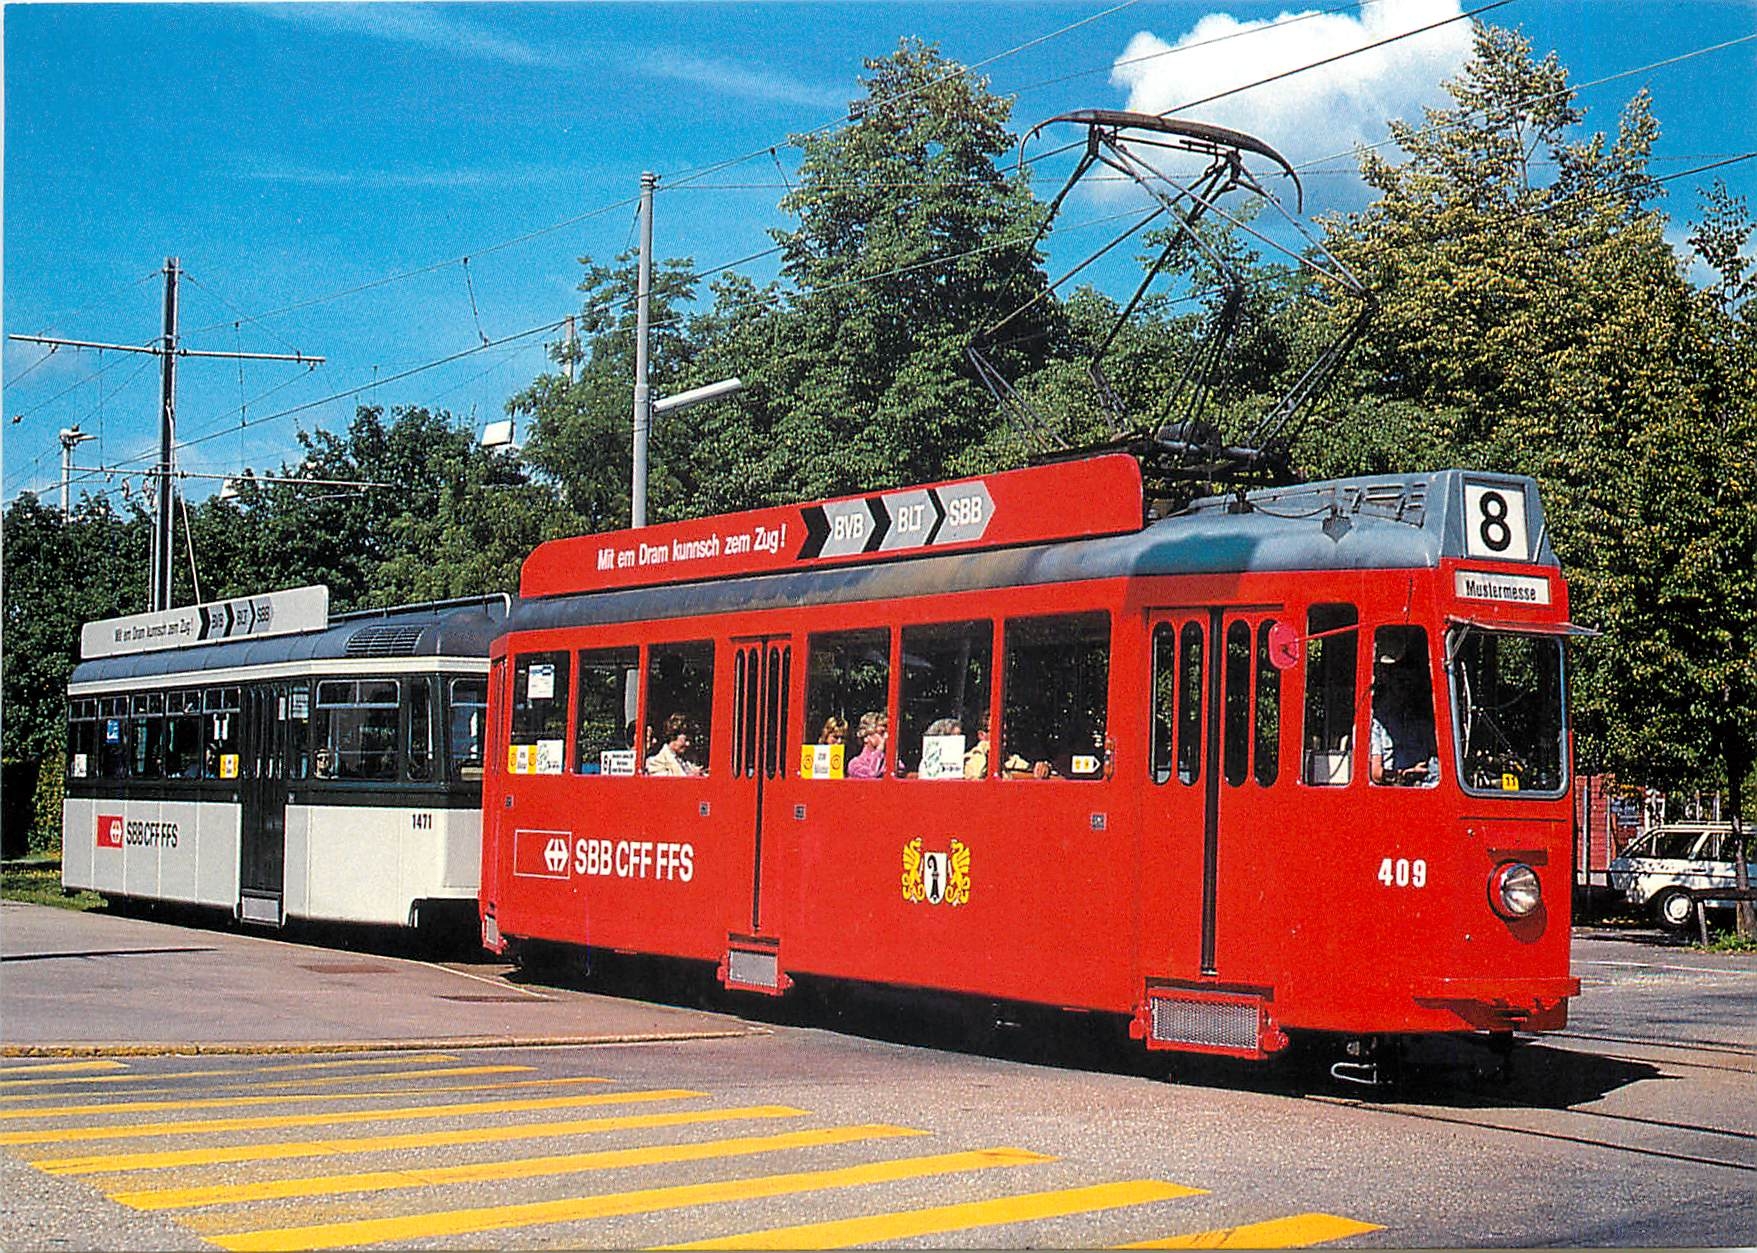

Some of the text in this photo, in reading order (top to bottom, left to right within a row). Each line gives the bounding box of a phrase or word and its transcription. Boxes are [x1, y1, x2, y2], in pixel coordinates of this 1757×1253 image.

[834, 496, 983, 541] BVB BLT SBB
[1480, 491, 1511, 552] 8
[597, 549, 614, 571] Mit
[617, 552, 635, 567] em
[639, 543, 668, 566] Dram
[672, 534, 719, 561] kunnsch
[724, 534, 750, 555] zem
[1465, 579, 1536, 601] Mustermesse
[257, 606, 270, 622] SBB
[126, 821, 178, 848] SBB CFF FFS
[412, 813, 432, 830] 1471
[575, 839, 694, 882] SBB CFF FFS
[1378, 858, 1427, 888] 409
